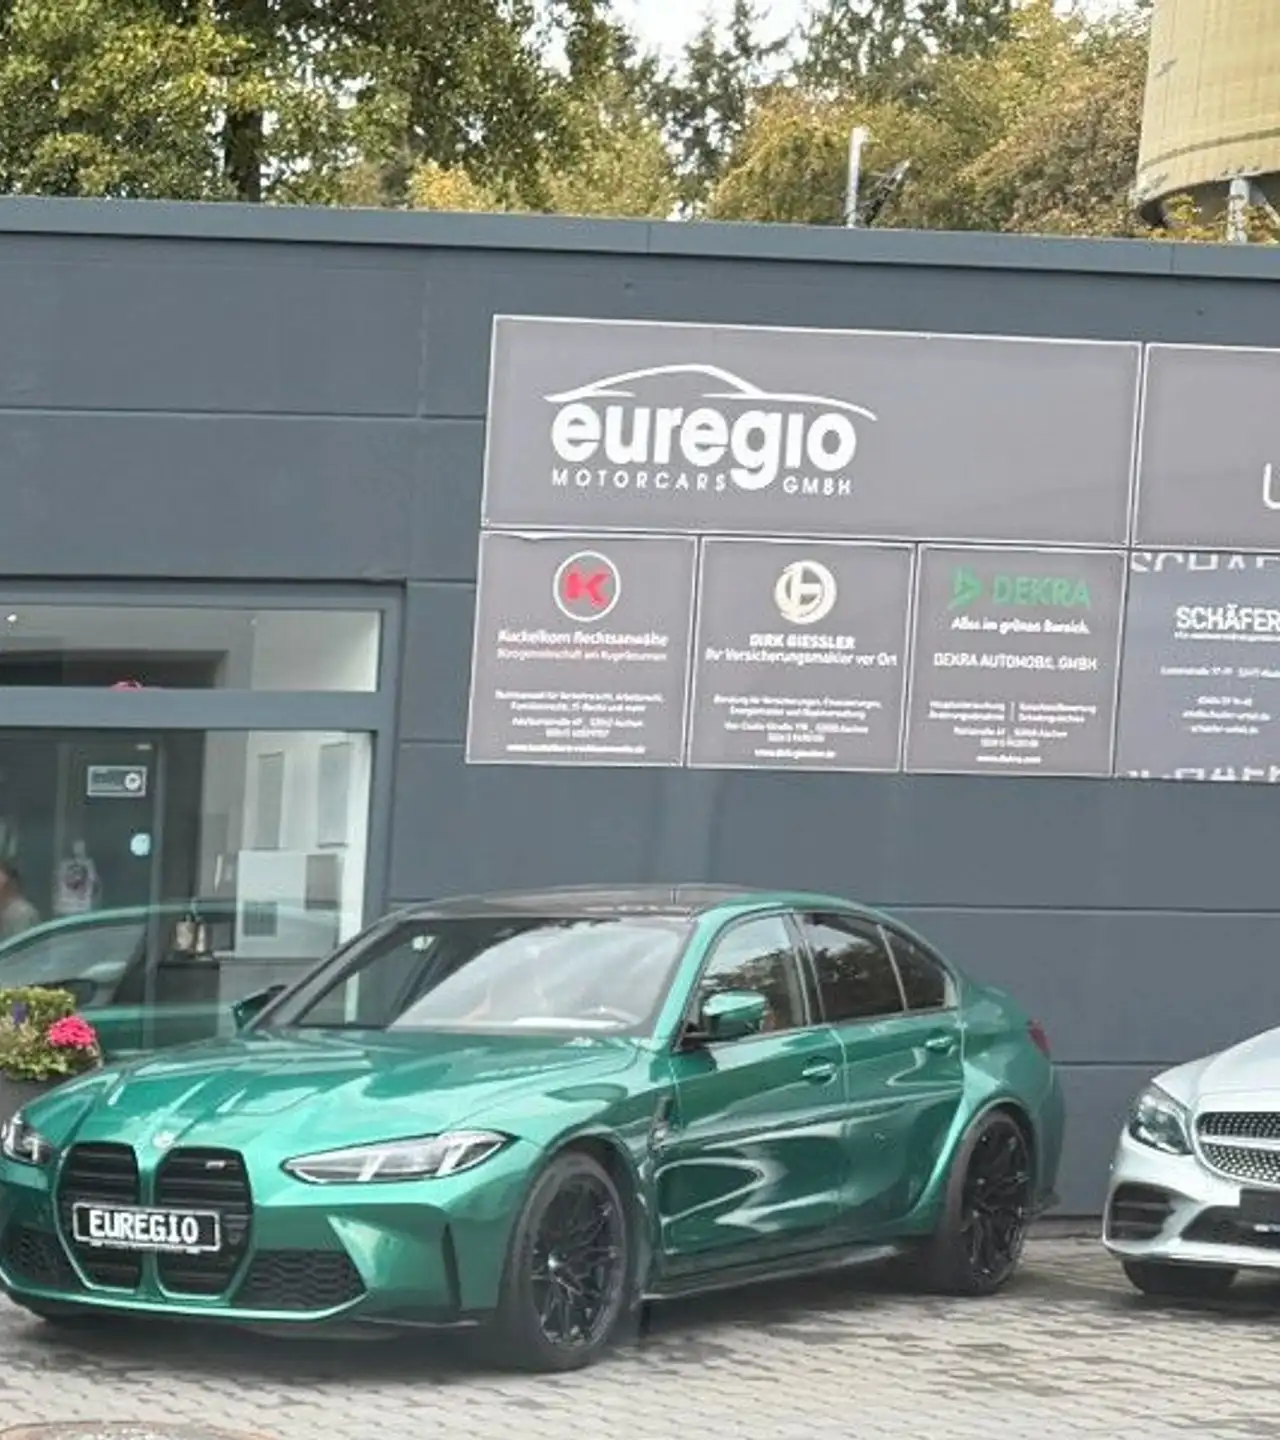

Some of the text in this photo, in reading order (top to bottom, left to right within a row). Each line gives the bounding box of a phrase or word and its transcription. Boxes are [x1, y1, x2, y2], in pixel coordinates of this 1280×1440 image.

[552, 403, 857, 490] euregio
[552, 468, 852, 496] MOTORCARS GMBH
[993, 575, 1091, 610] DEKRA
[1175, 603, 1280, 632] SCHÄFER
[90, 1210, 199, 1244] EUREGIO
